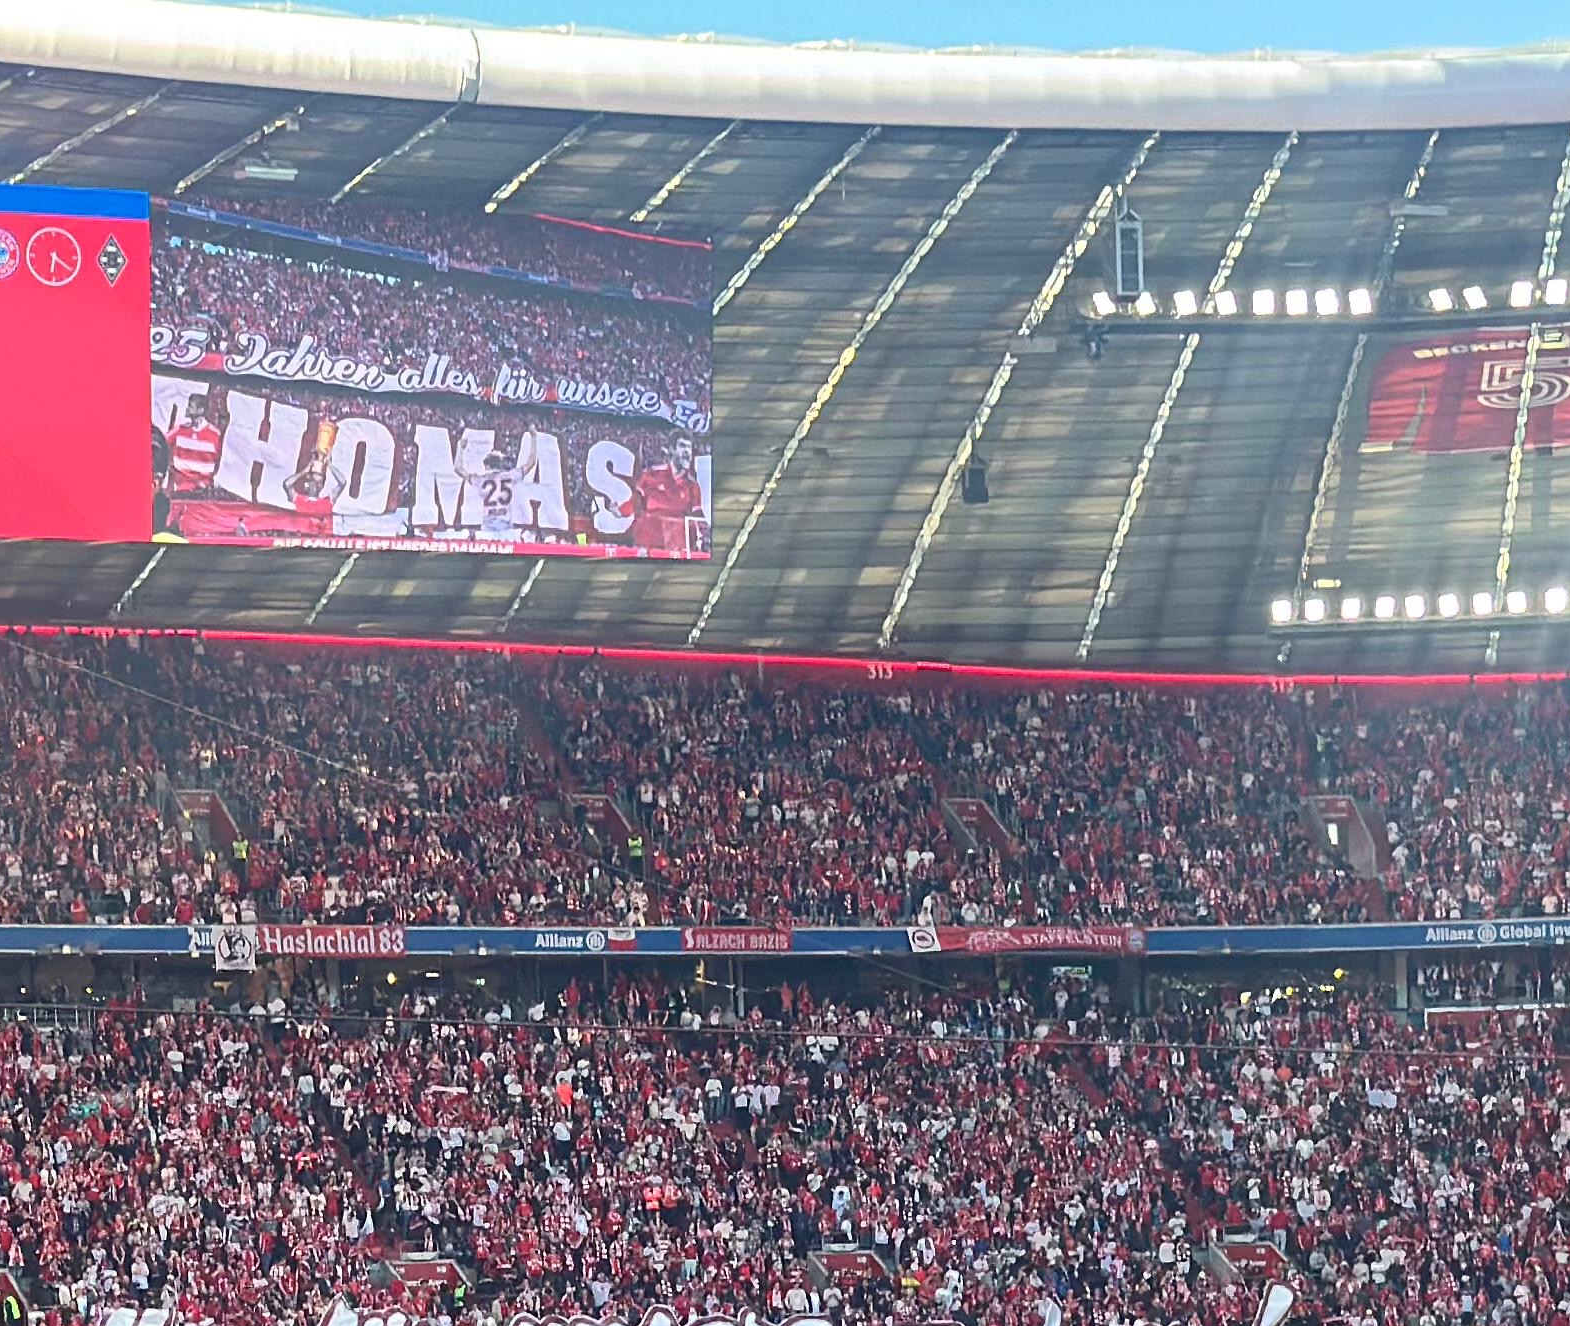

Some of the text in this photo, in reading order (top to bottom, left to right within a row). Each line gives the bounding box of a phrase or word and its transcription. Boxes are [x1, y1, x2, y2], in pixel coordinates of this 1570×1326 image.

[225, 332, 384, 389] Jahren
[399, 353, 481, 399] alles
[492, 363, 545, 406] für
[557, 378, 662, 413] unsere
[481, 479, 514, 507] 25
[379, 929, 404, 953] 83
[535, 932, 584, 949] Allianz
[1425, 926, 1475, 943] Allianz
[1499, 924, 1547, 940] Global
